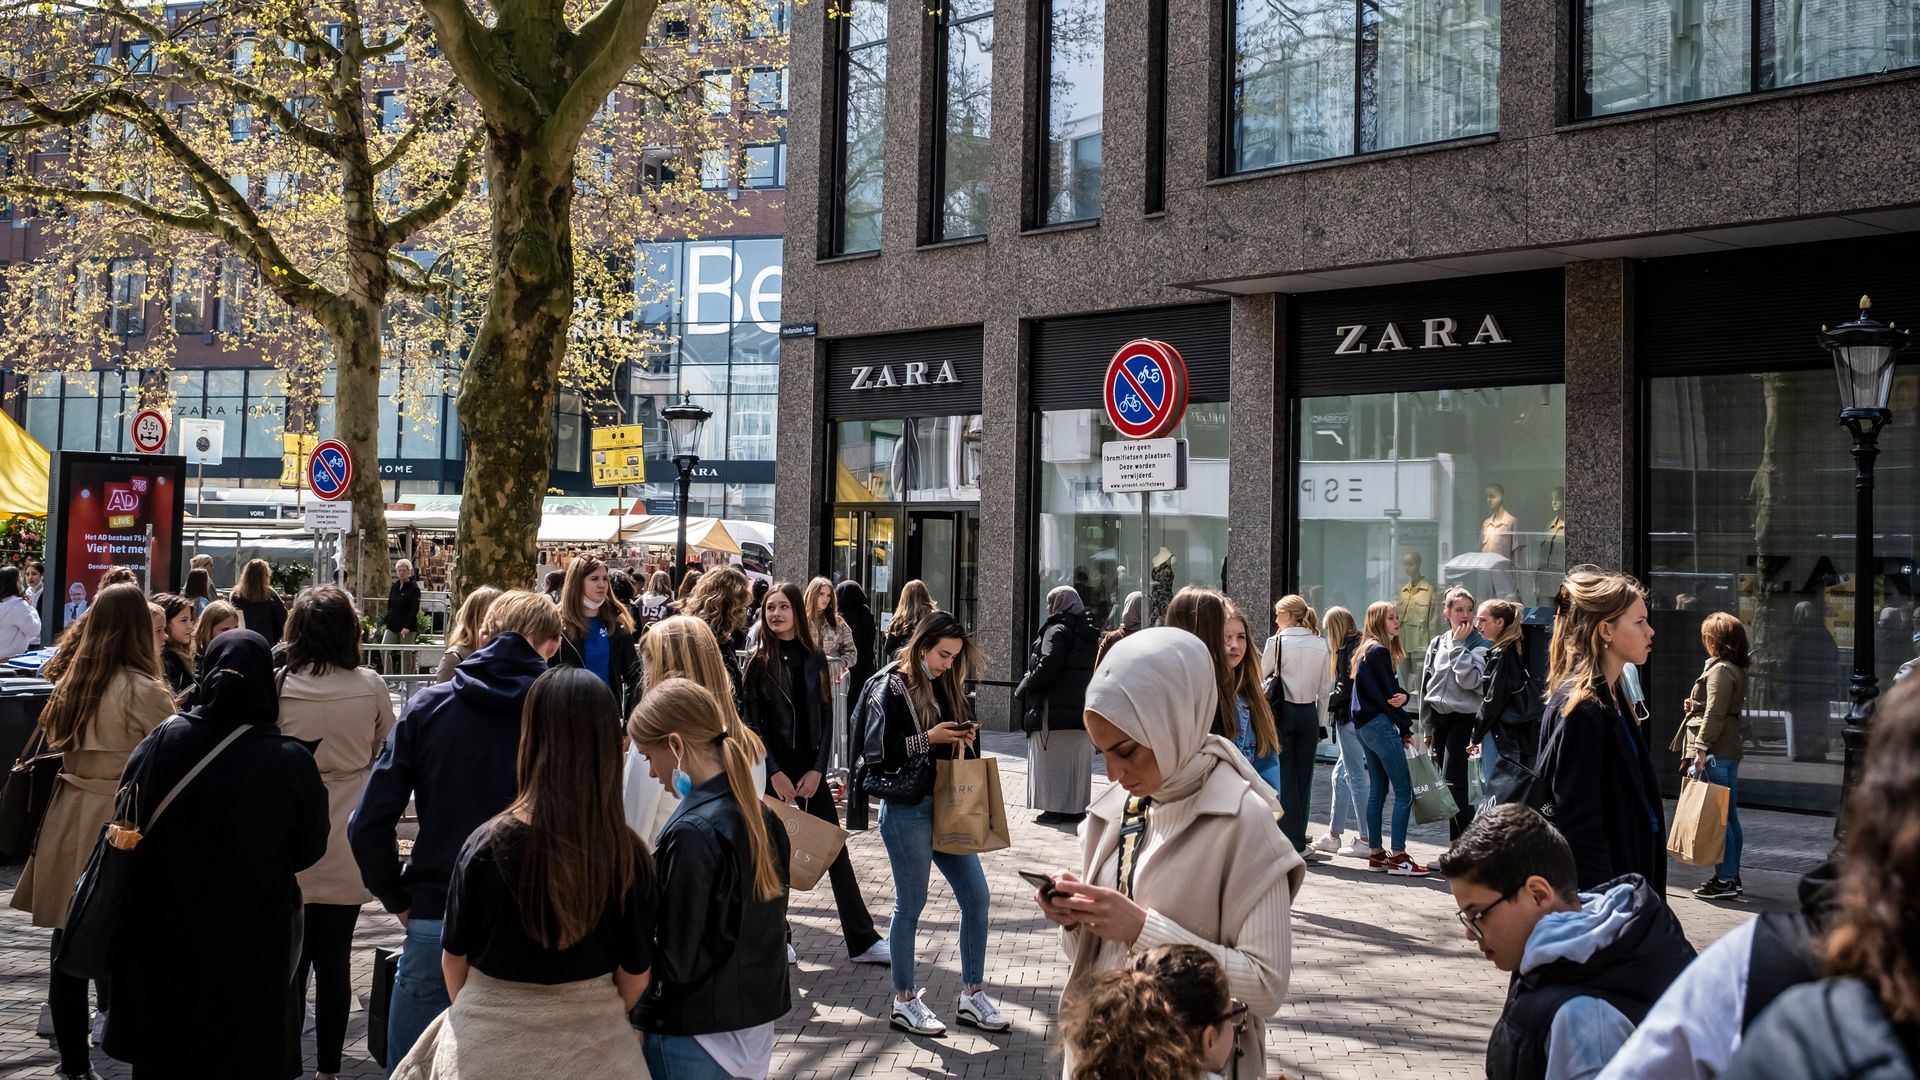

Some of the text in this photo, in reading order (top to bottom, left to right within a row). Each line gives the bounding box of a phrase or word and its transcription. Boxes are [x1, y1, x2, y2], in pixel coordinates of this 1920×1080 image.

[1335, 313, 1512, 357] ZARA
[850, 360, 962, 391] ZARA
[178, 405, 284, 416] ZARA HOME
[1124, 444, 1152, 452] hier geen
[1104, 452, 1173, 463] (brom)fietsen plaatsen.
[1135, 462, 1156, 470] worden
[690, 468, 718, 476] ARA
[1121, 471, 1154, 480] verwijderd.
[132, 479, 147, 491] 75
[107, 489, 139, 511] AD
[113, 516, 131, 526] LIVE
[108, 534, 133, 542] bestaat
[87, 544, 108, 554] Vier
[109, 544, 126, 554] het
